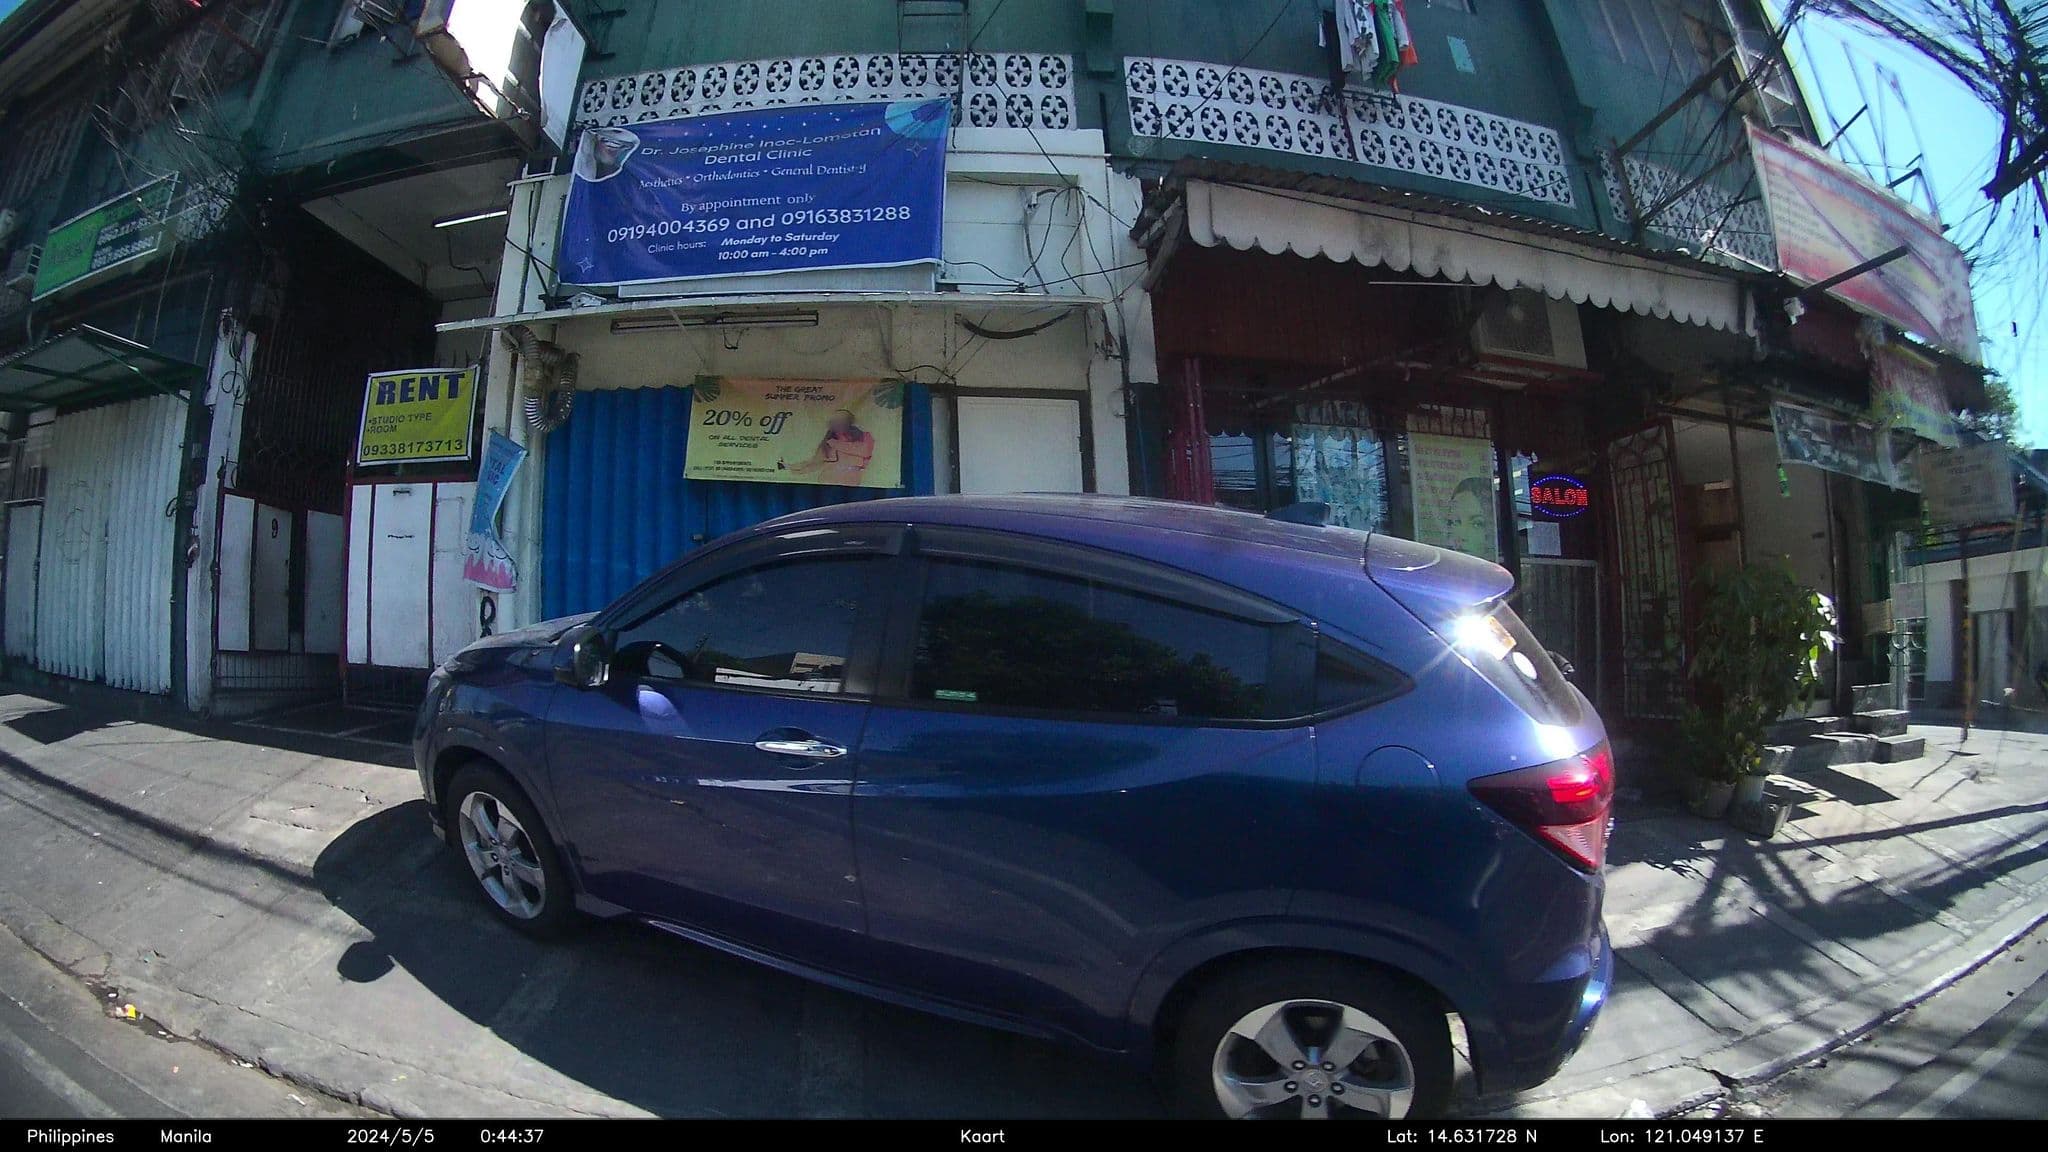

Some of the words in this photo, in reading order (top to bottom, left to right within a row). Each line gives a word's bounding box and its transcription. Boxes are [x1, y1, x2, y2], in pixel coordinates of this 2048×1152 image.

[640, 147, 664, 156] Dr.
[668, 141, 755, 156] Josephine
[704, 151, 761, 166] Dental
[766, 149, 813, 161] Clinic
[638, 176, 684, 190] Aesthetics
[693, 168, 761, 184] Orthodontics
[771, 164, 814, 177] General
[681, 202, 697, 214] By
[699, 196, 782, 213] appointment
[787, 193, 816, 205] only
[607, 217, 730, 243] 09194004369
[735, 214, 775, 230] and
[781, 206, 911, 226] 09163831288
[647, 242, 675, 254] Clinic
[677, 240, 707, 250] hours:
[720, 234, 768, 246] Monday
[770, 234, 783, 243] to
[784, 231, 840, 244] Saturday
[718, 249, 749, 261] 10:00
[750, 251, 770, 259] am
[779, 247, 807, 257] 4:00
[808, 247, 829, 258] pm
[376, 373, 466, 406] RENT
[776, 385, 792, 393] THE
[803, 393, 836, 402] PROMO
[407, 413, 433, 423] TYPE
[703, 409, 753, 427] 20%
[760, 411, 793, 435] off
[363, 439, 464, 457] 09338173713
[1531, 487, 1588, 506] SALON
